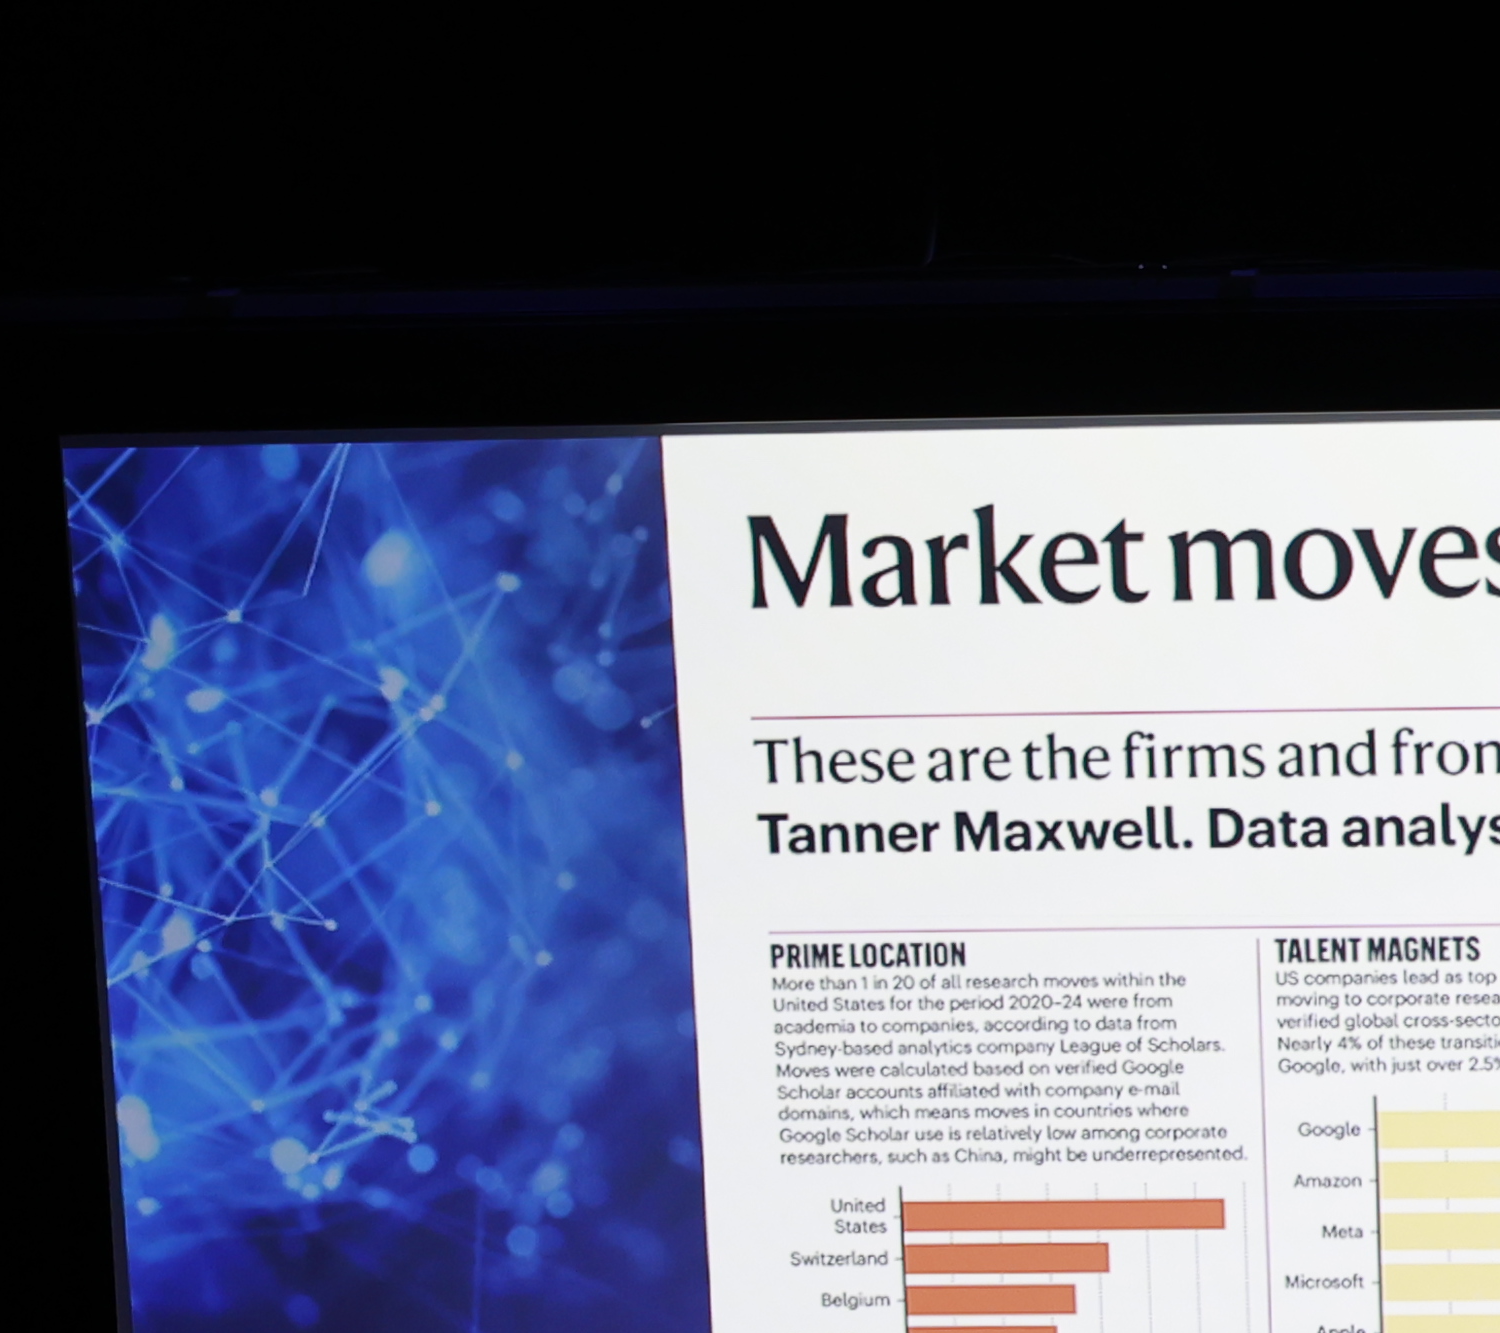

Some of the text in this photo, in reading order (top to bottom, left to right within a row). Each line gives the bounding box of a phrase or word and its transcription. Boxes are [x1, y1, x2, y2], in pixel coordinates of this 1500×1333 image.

[747, 504, 1149, 609] Market
[754, 737, 914, 784] These
[928, 747, 1010, 783] are
[1023, 732, 1109, 781] the
[1124, 730, 1265, 778] firms
[1279, 728, 1376, 778] and
[757, 813, 939, 855] Tanner
[954, 806, 1192, 852] Maxwell.
[1209, 807, 1328, 849] Data
[771, 942, 965, 968] PRIME LOCATION
[1275, 935, 1480, 963] TALENT MAGNETS
[1275, 969, 1300, 987] US
[1303, 972, 1398, 989] companies
[1402, 968, 1440, 986] lead
[1444, 972, 1463, 985] as
[1467, 970, 1498, 988] top
[775, 1058, 1185, 1079] Moves were calculated based on verified Google
[1297, 1120, 1361, 1141] Google
[1293, 1173, 1363, 1190] Amazon
[830, 1197, 886, 1214] United
[834, 1218, 888, 1235] States
[1321, 1224, 1364, 1240] Meta
[790, 1249, 889, 1268] Switzerland
[1284, 1272, 1364, 1290] Microsoft
[821, 1290, 891, 1311] Belgium
